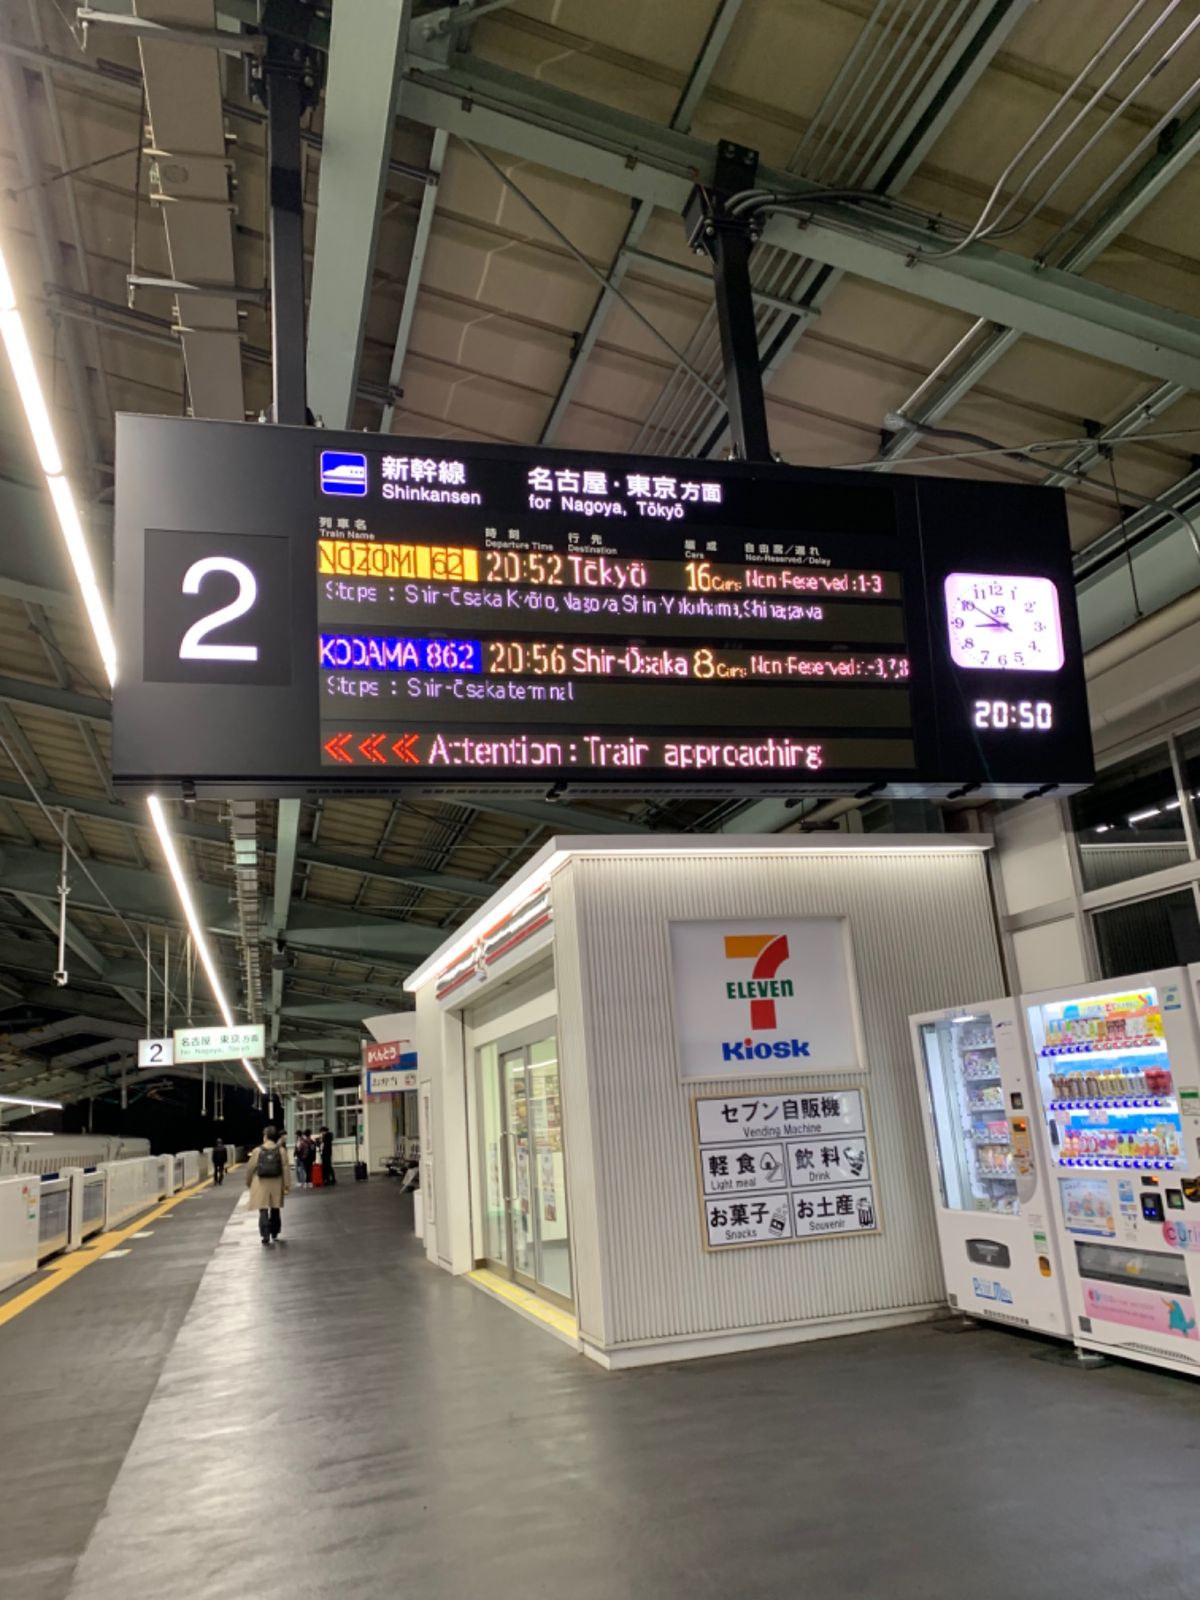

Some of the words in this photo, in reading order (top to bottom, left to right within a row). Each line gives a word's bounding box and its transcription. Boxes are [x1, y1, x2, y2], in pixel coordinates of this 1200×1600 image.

[382, 456, 466, 485] 新幹線
[382, 485, 481, 505] Shinkansen
[529, 494, 551, 509] for
[561, 496, 627, 516] Nagoya,
[637, 501, 684, 520] Tōkyō
[320, 529, 346, 539] Train
[347, 531, 375, 540] Name
[532, 542, 554, 551] Time
[431, 551, 464, 577] 62
[486, 551, 563, 585] 20:52
[685, 562, 711, 592] 16
[179, 556, 258, 661] 2
[319, 636, 418, 666] KODAMA
[427, 643, 473, 670] 862
[490, 642, 566, 674] 20:56
[693, 648, 715, 678] 8
[974, 700, 1052, 729] 20:50
[428, 733, 562, 765] Attention
[583, 736, 648, 765] Train
[664, 738, 823, 769] approaching
[150, 1043, 163, 1062] 2
[722, 1038, 810, 1061] Kiosk
[722, 1097, 840, 1124] セブン自販機
[743, 1125, 781, 1138] Vending
[783, 1123, 822, 1135] Machine
[709, 1152, 756, 1178] 軽食
[795, 1146, 840, 1171] 飲料
[711, 1180, 735, 1192] Light
[736, 1178, 756, 1188] meal
[809, 1171, 831, 1182] Drink
[710, 1202, 769, 1228] お菓子
[797, 1194, 855, 1219] お土産
[725, 1229, 757, 1240] Snacks
[809, 1218, 846, 1231] Souvenir
